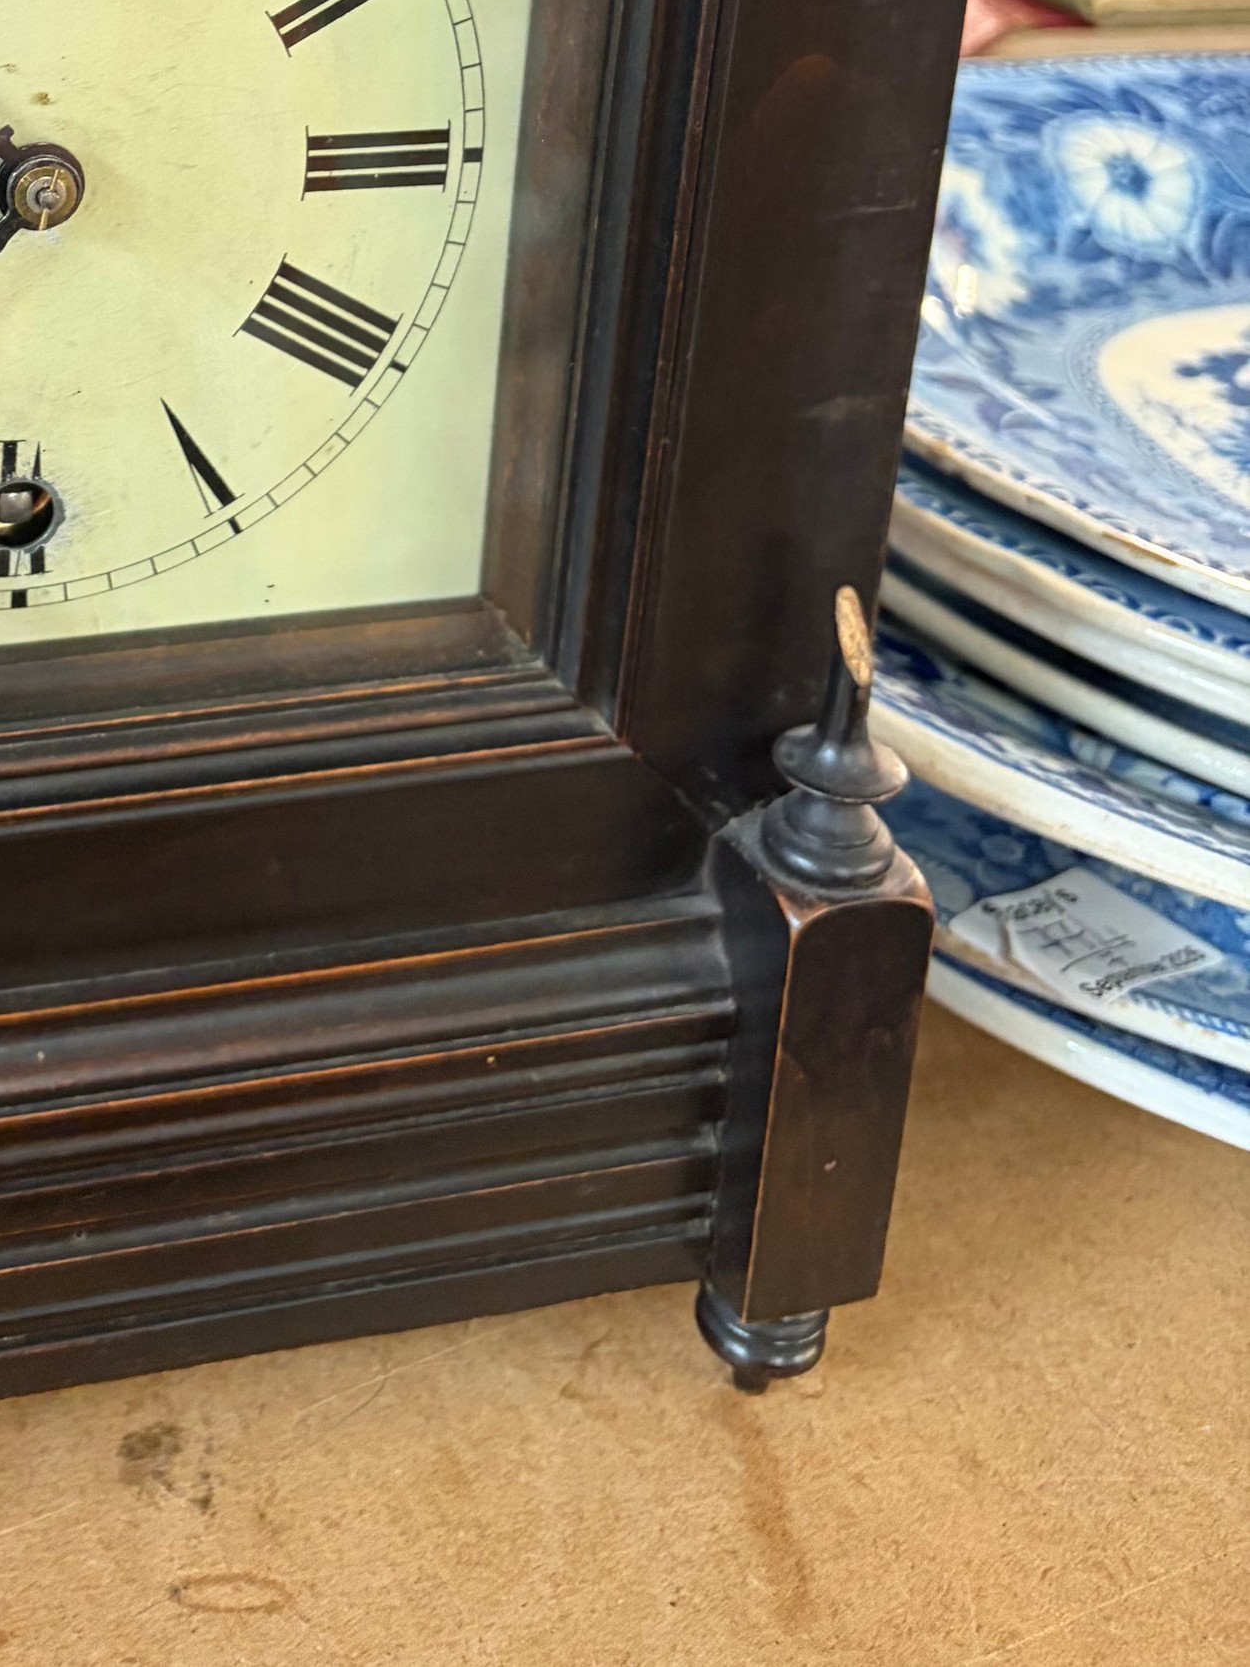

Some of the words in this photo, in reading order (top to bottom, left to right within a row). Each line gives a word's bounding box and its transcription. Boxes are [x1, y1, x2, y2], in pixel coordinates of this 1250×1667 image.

[301, 119, 451, 201] III
[233, 252, 404, 397] IIII
[160, 397, 245, 518] V
